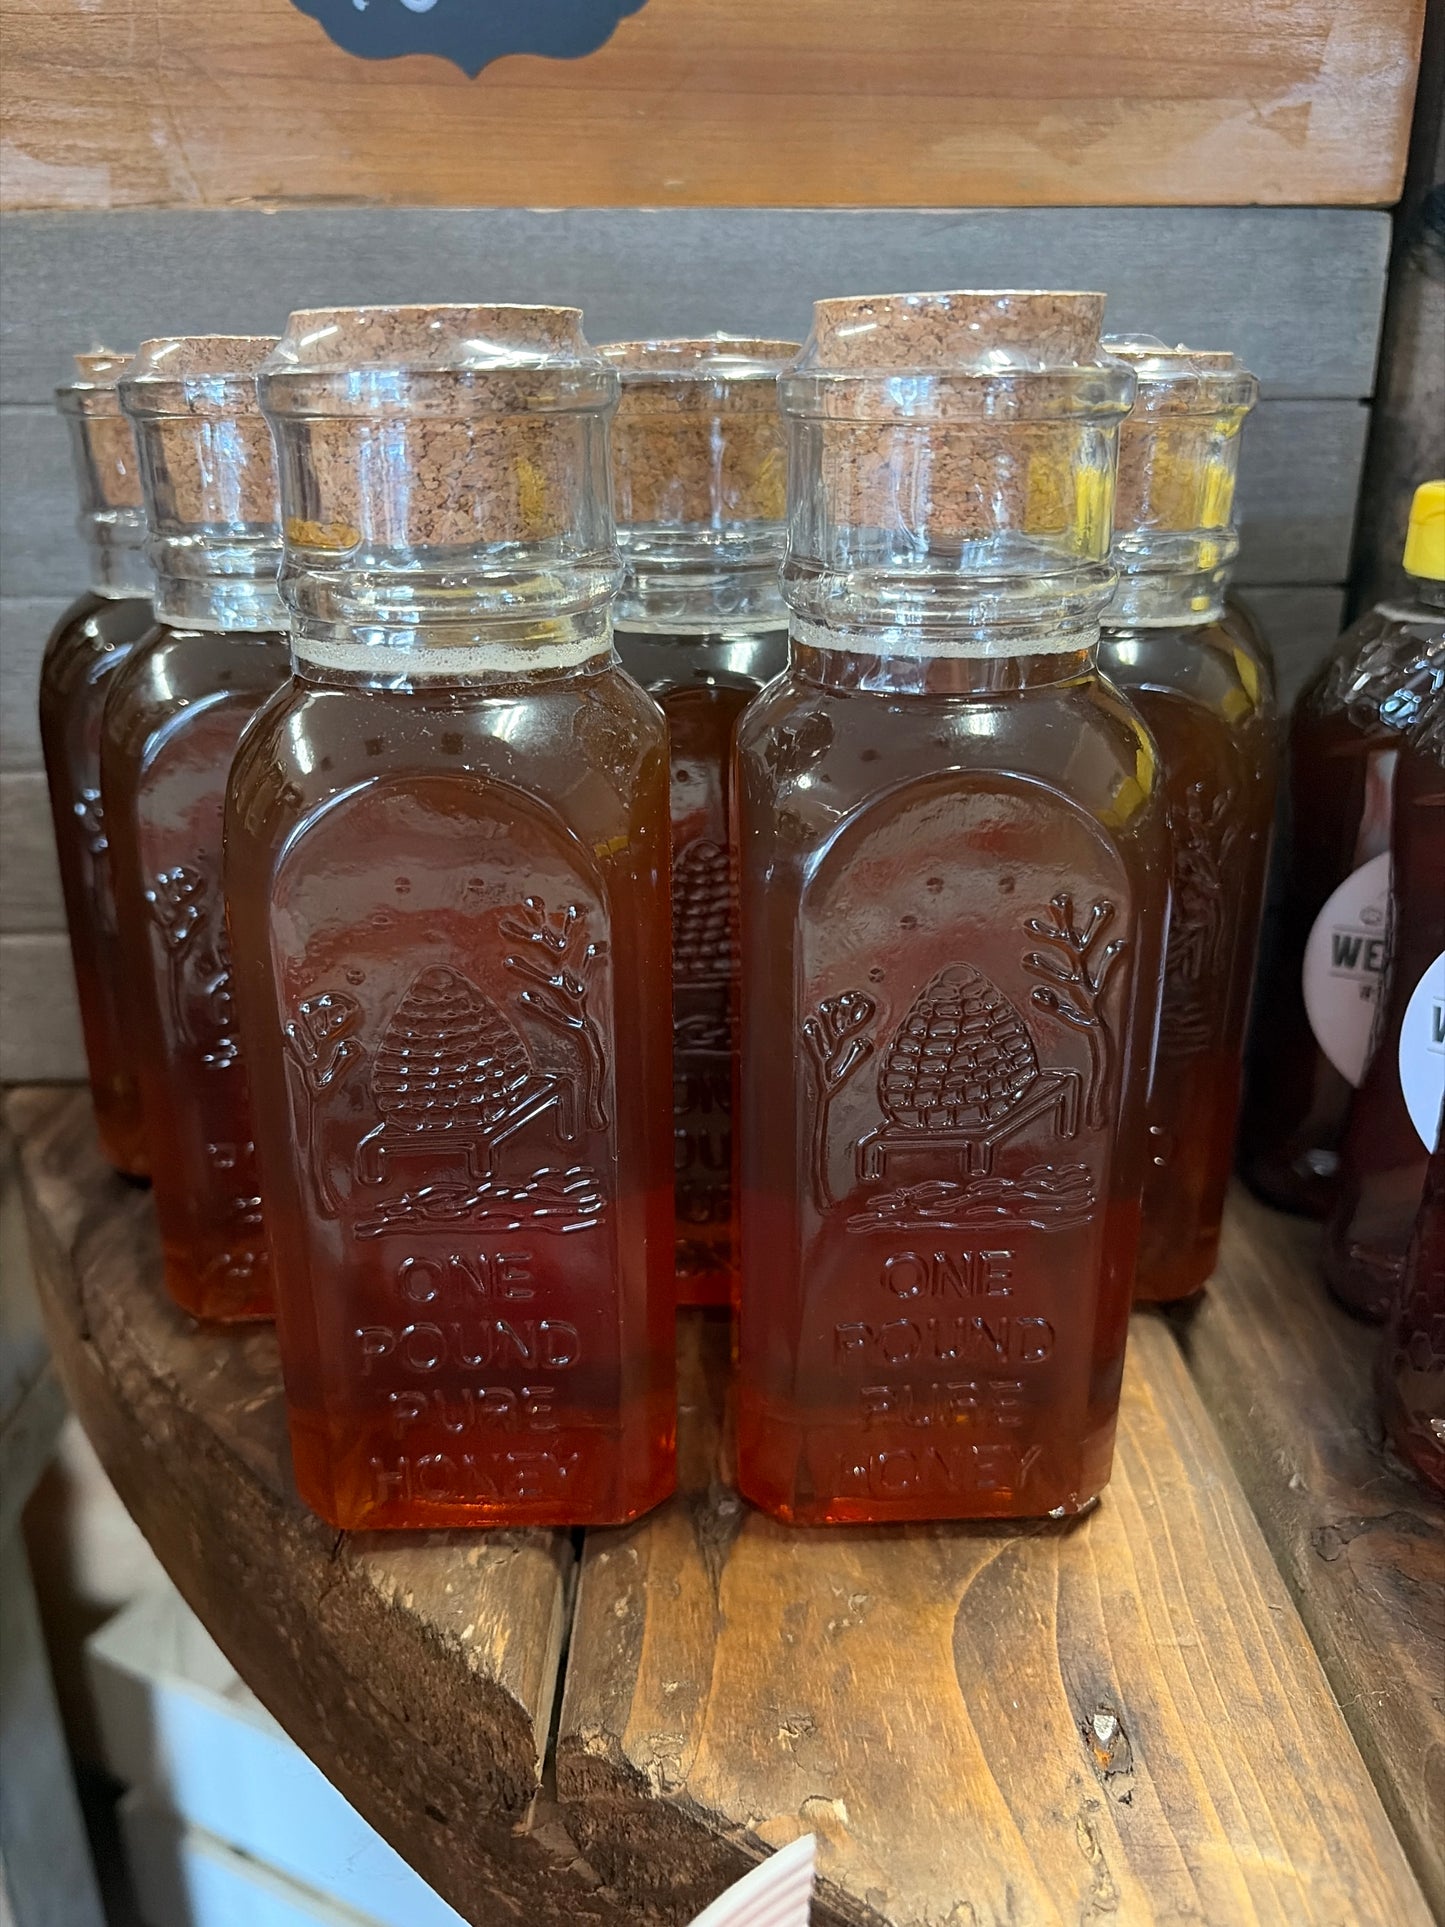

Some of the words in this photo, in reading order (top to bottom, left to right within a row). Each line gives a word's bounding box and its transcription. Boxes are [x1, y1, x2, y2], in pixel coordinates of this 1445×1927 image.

[399, 1252, 535, 1302] ONE
[881, 1250, 1015, 1299] ONE
[356, 1320, 581, 1375] POUND
[833, 1316, 1055, 1366] POUND
[389, 1387, 557, 1437] PURE
[861, 1380, 1024, 1431] PURE
[369, 1451, 581, 1505] HONEY
[838, 1445, 1042, 1494] HONEY
